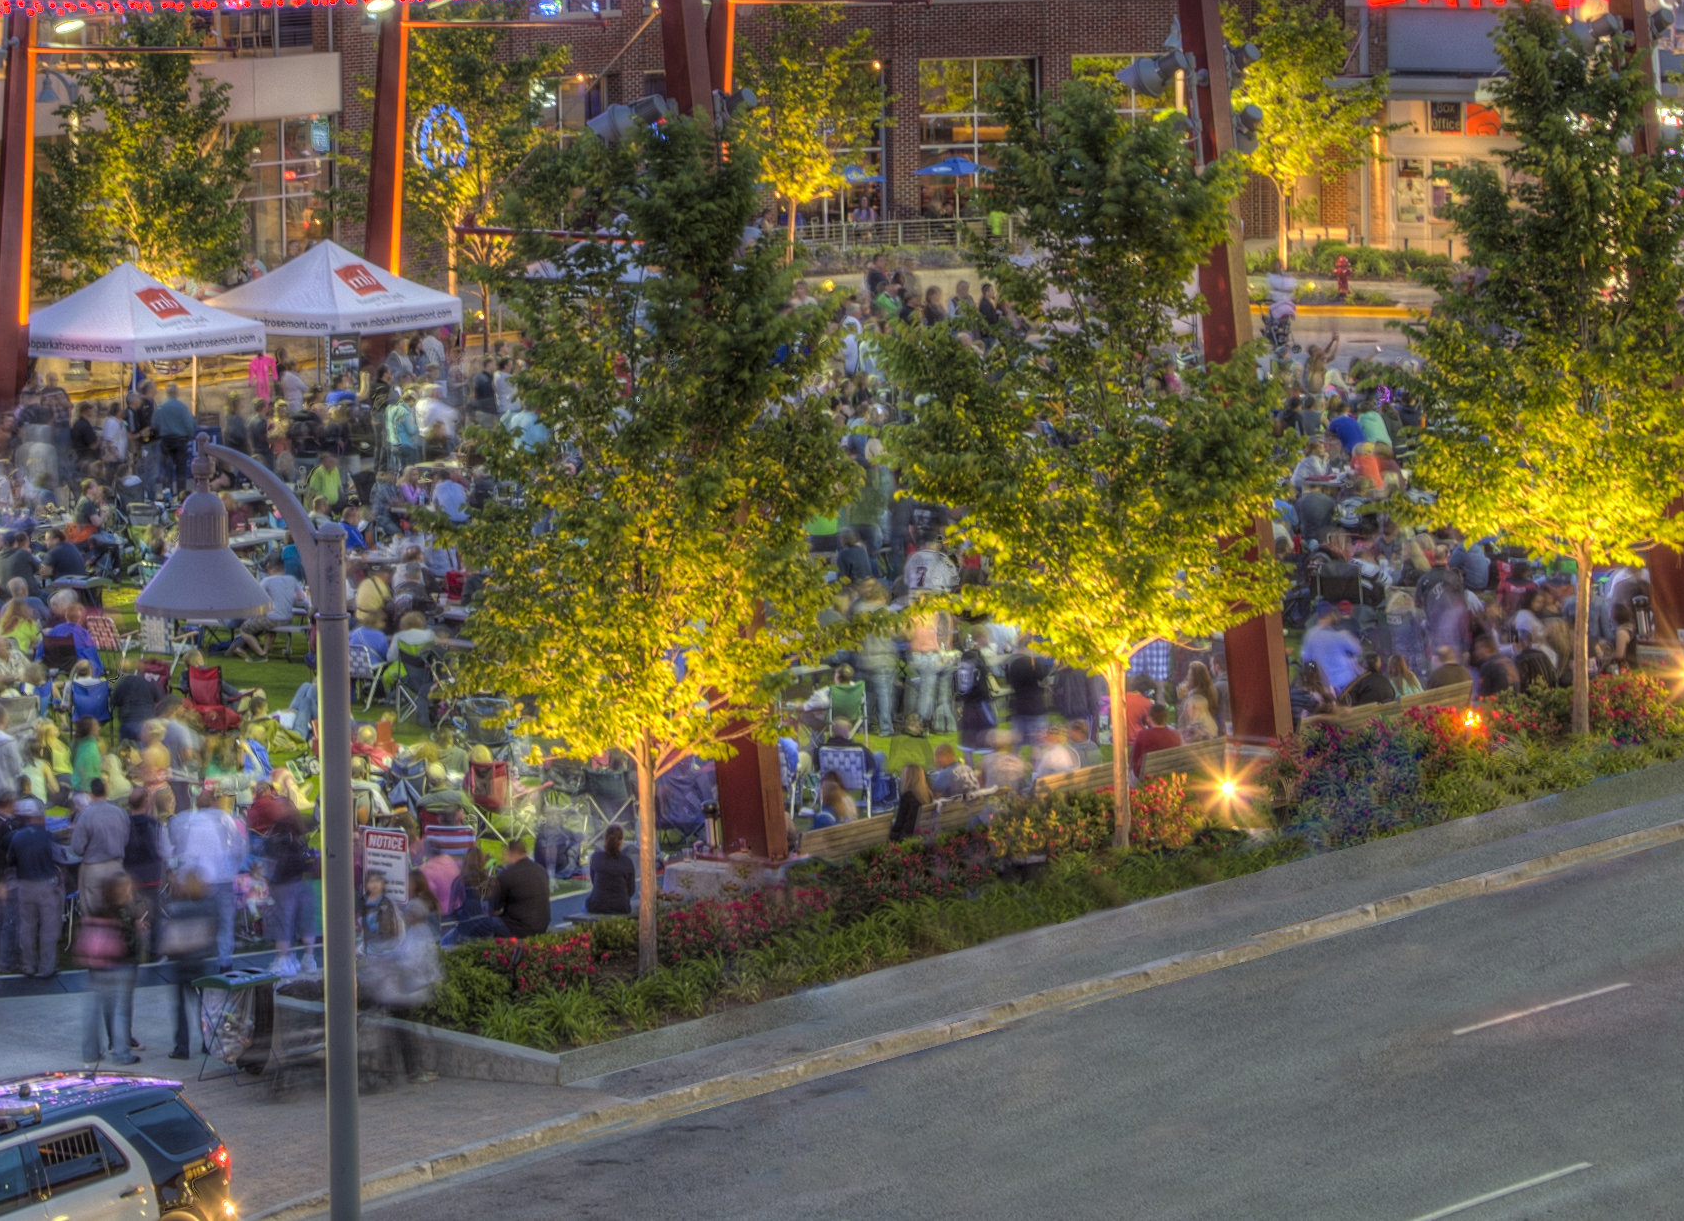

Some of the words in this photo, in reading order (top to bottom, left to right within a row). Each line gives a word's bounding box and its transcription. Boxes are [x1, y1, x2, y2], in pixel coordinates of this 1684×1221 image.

[349, 269, 378, 290] mb
[149, 292, 179, 312] mb
[368, 833, 404, 850] NOTICE
